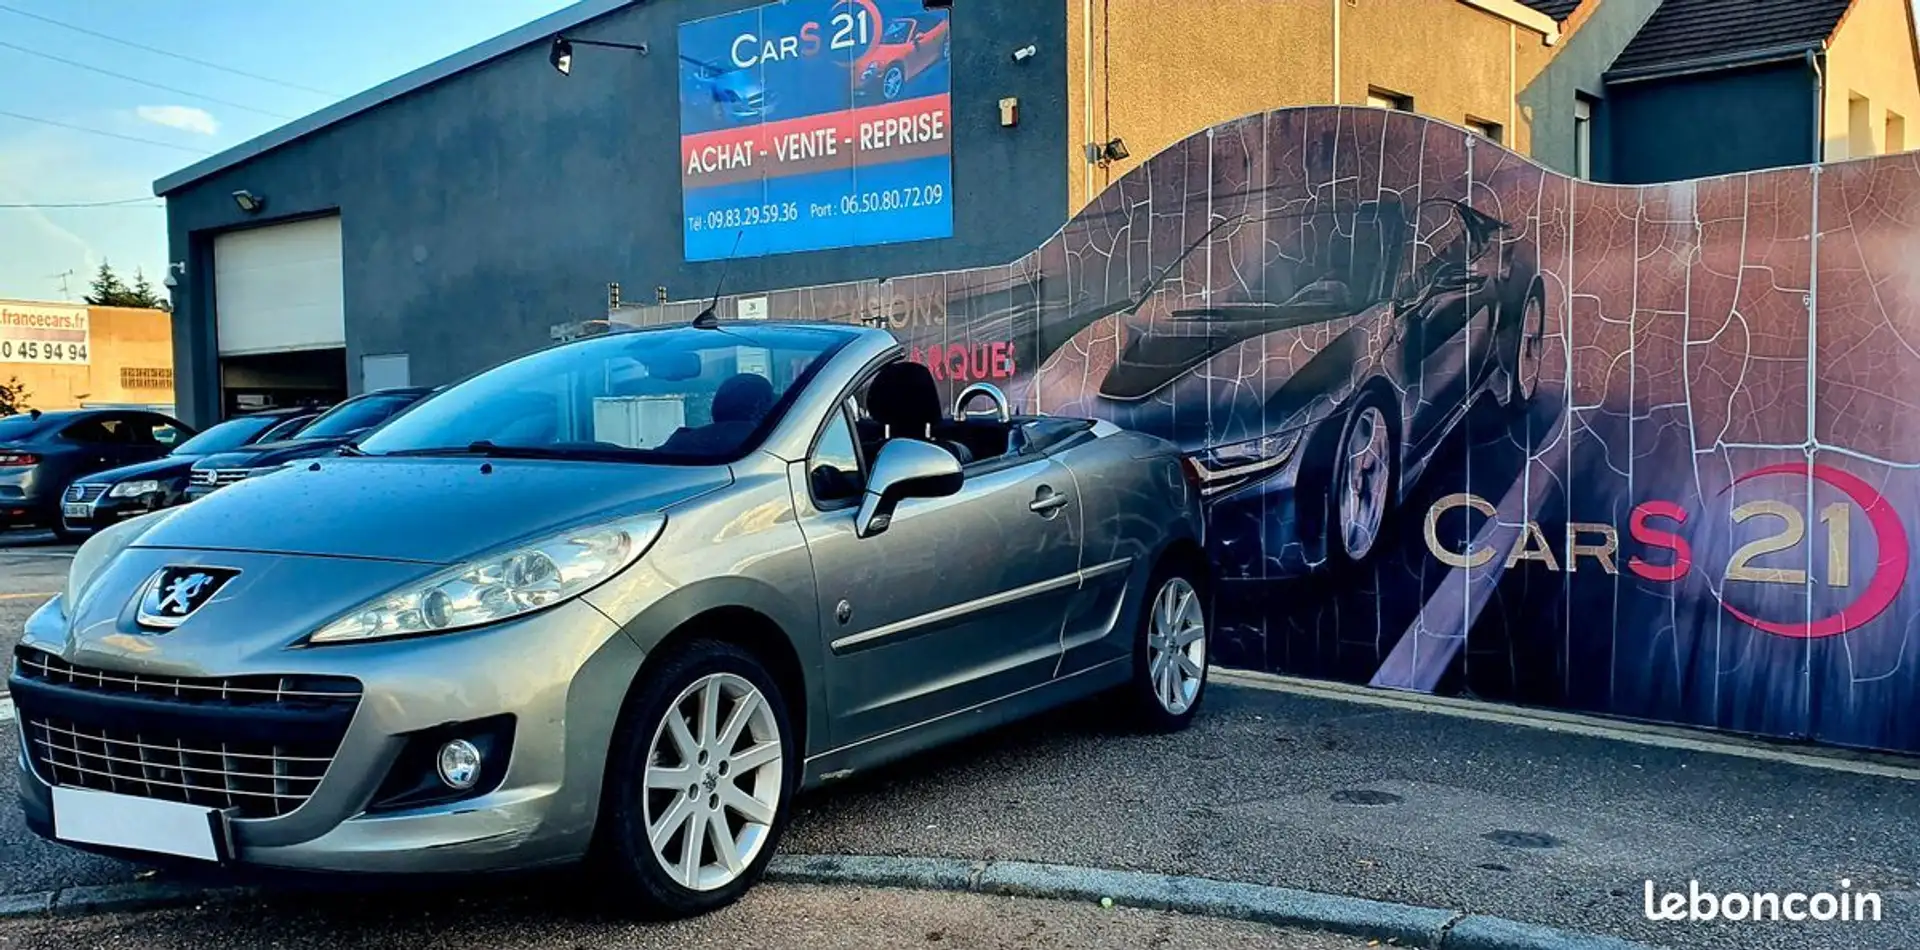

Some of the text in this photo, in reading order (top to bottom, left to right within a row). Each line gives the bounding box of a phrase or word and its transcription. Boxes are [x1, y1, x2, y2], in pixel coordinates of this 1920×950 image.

[830, 9, 868, 50] 21
[687, 140, 754, 175] ACHAT
[774, 128, 837, 162] VENTE
[860, 111, 944, 150] REPRISE
[708, 202, 798, 229] 09.83.29.59.36
[840, 184, 943, 215] 06.50.80.72.09
[18, 341, 38, 359] 45
[43, 343, 63, 360] 94
[68, 344, 88, 361] 94
[1726, 499, 1851, 587] 21
